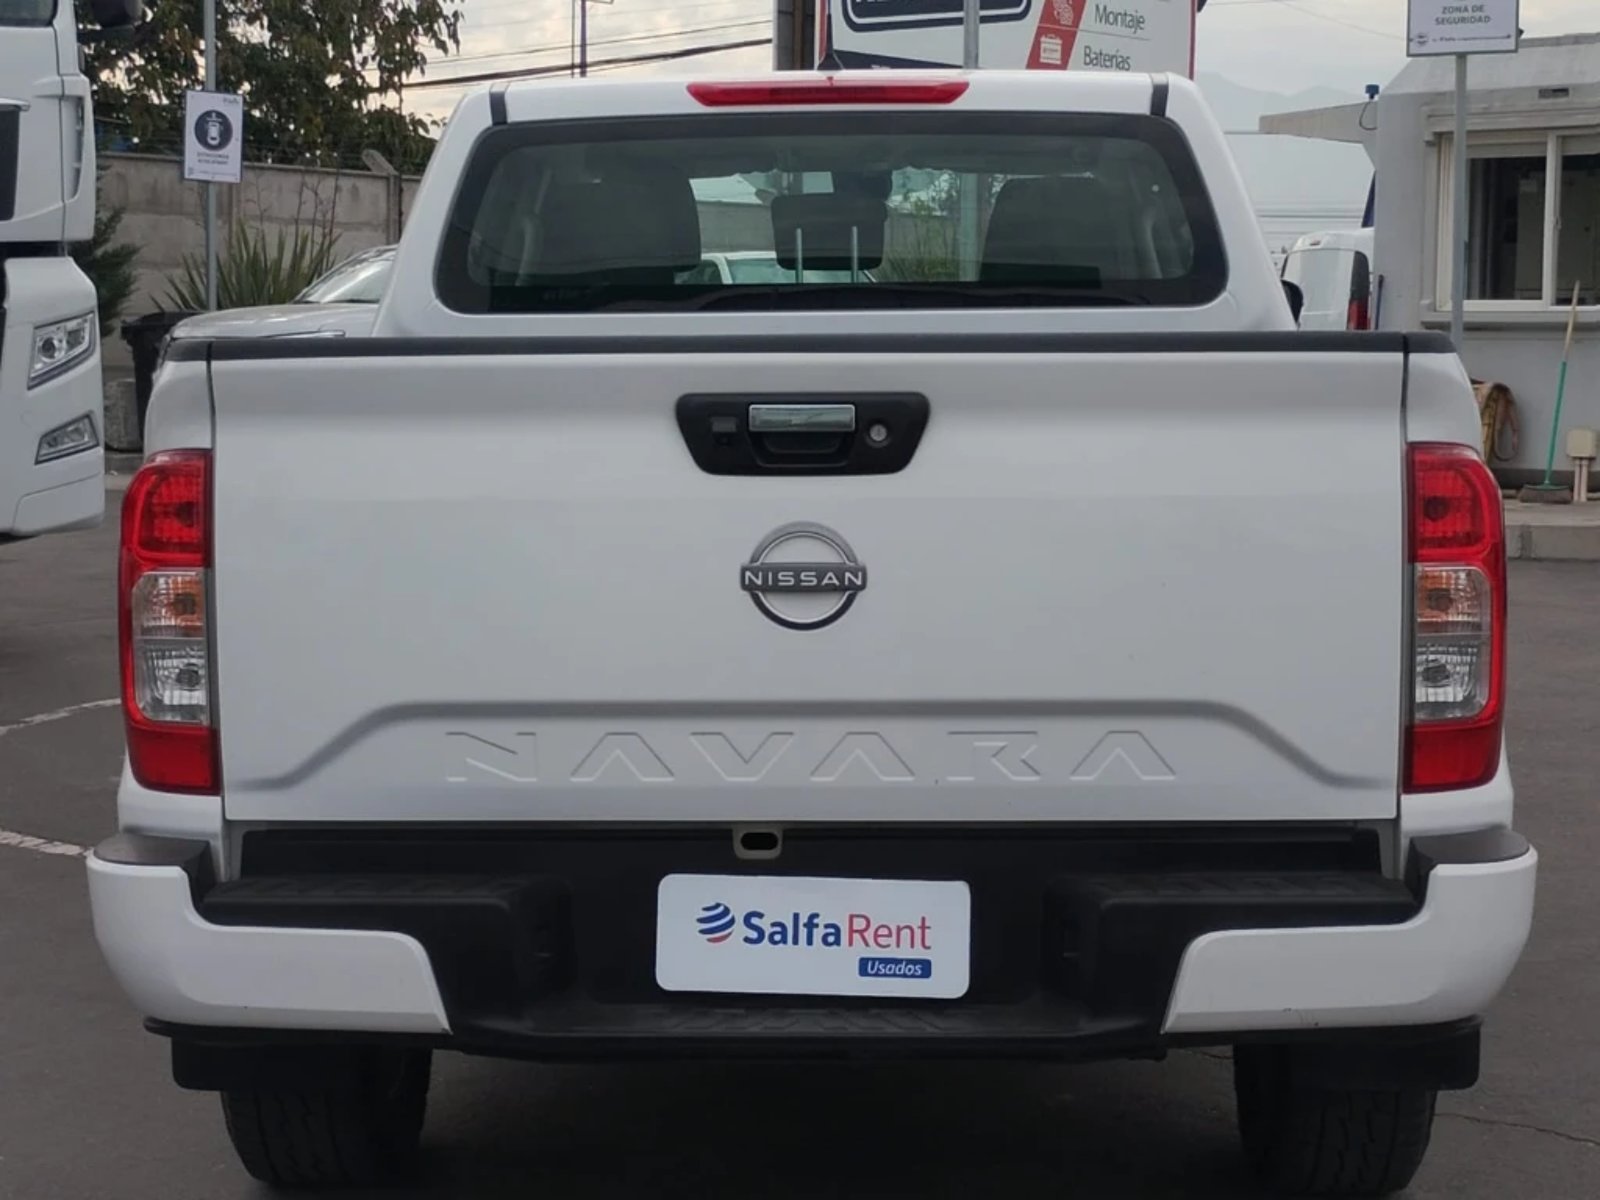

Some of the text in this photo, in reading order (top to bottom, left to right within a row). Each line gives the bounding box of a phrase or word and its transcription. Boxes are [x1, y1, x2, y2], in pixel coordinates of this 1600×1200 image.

[1441, 4, 1485, 14] ZONA DE
[1094, 3, 1145, 34] Montaje
[1434, 15, 1491, 25] SEGURIDAD
[1083, 45, 1131, 71] Baterías
[744, 570, 863, 586] NISSAN
[445, 731, 1176, 783] NAVARA
[867, 960, 922, 976] Usados
